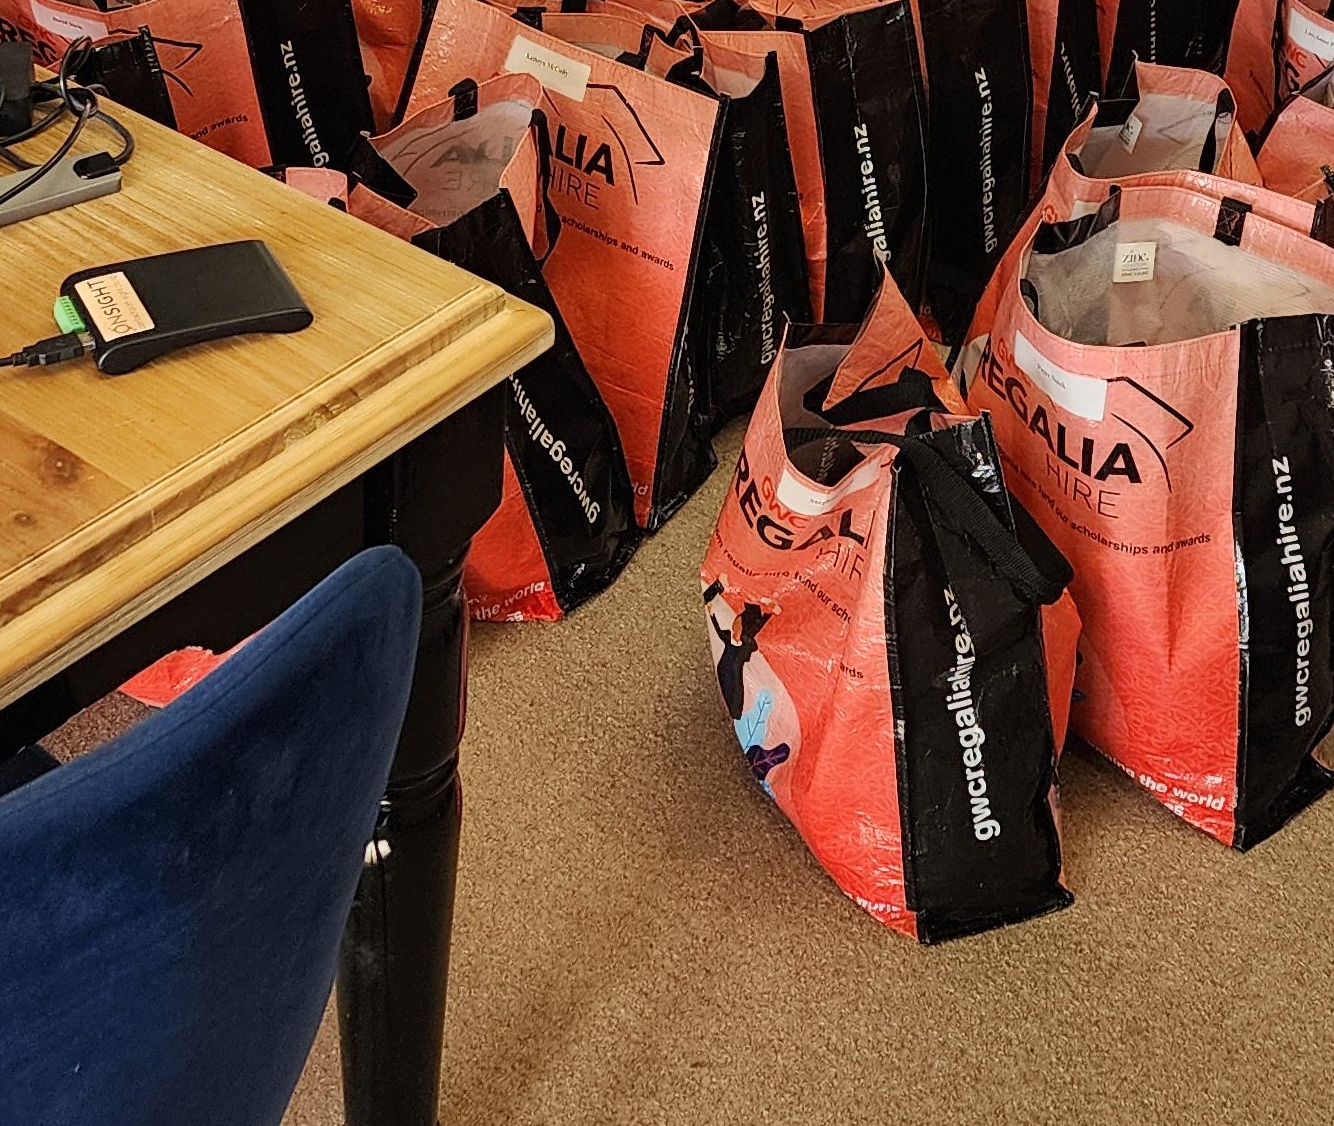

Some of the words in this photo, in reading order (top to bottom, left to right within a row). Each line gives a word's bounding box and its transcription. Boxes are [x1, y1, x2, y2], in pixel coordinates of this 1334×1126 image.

[209, 113, 249, 132] awards
[279, 40, 330, 168] galiahire.nz
[975, 67, 998, 254] gwcregaliahire.nz
[854, 123, 892, 263] galiahire.nz
[561, 214, 619, 249] scholarships
[620, 240, 638, 256] and
[640, 247, 675, 272] awards
[979, 344, 1143, 485] REGALIA
[734, 456, 877, 552] REGALI
[759, 475, 809, 530] GWC
[1047, 459, 1120, 520] HIRE
[1071, 521, 1149, 556] scholarships
[1151, 541, 1174, 555] and
[816, 589, 833, 607] our
[1271, 456, 1312, 728] gwcregaliahire.nz
[838, 661, 864, 680] ards
[940, 588, 1002, 842] gwcregaliahire.nz
[1139, 771, 1169, 794] the
[1172, 782, 1226, 813] world
